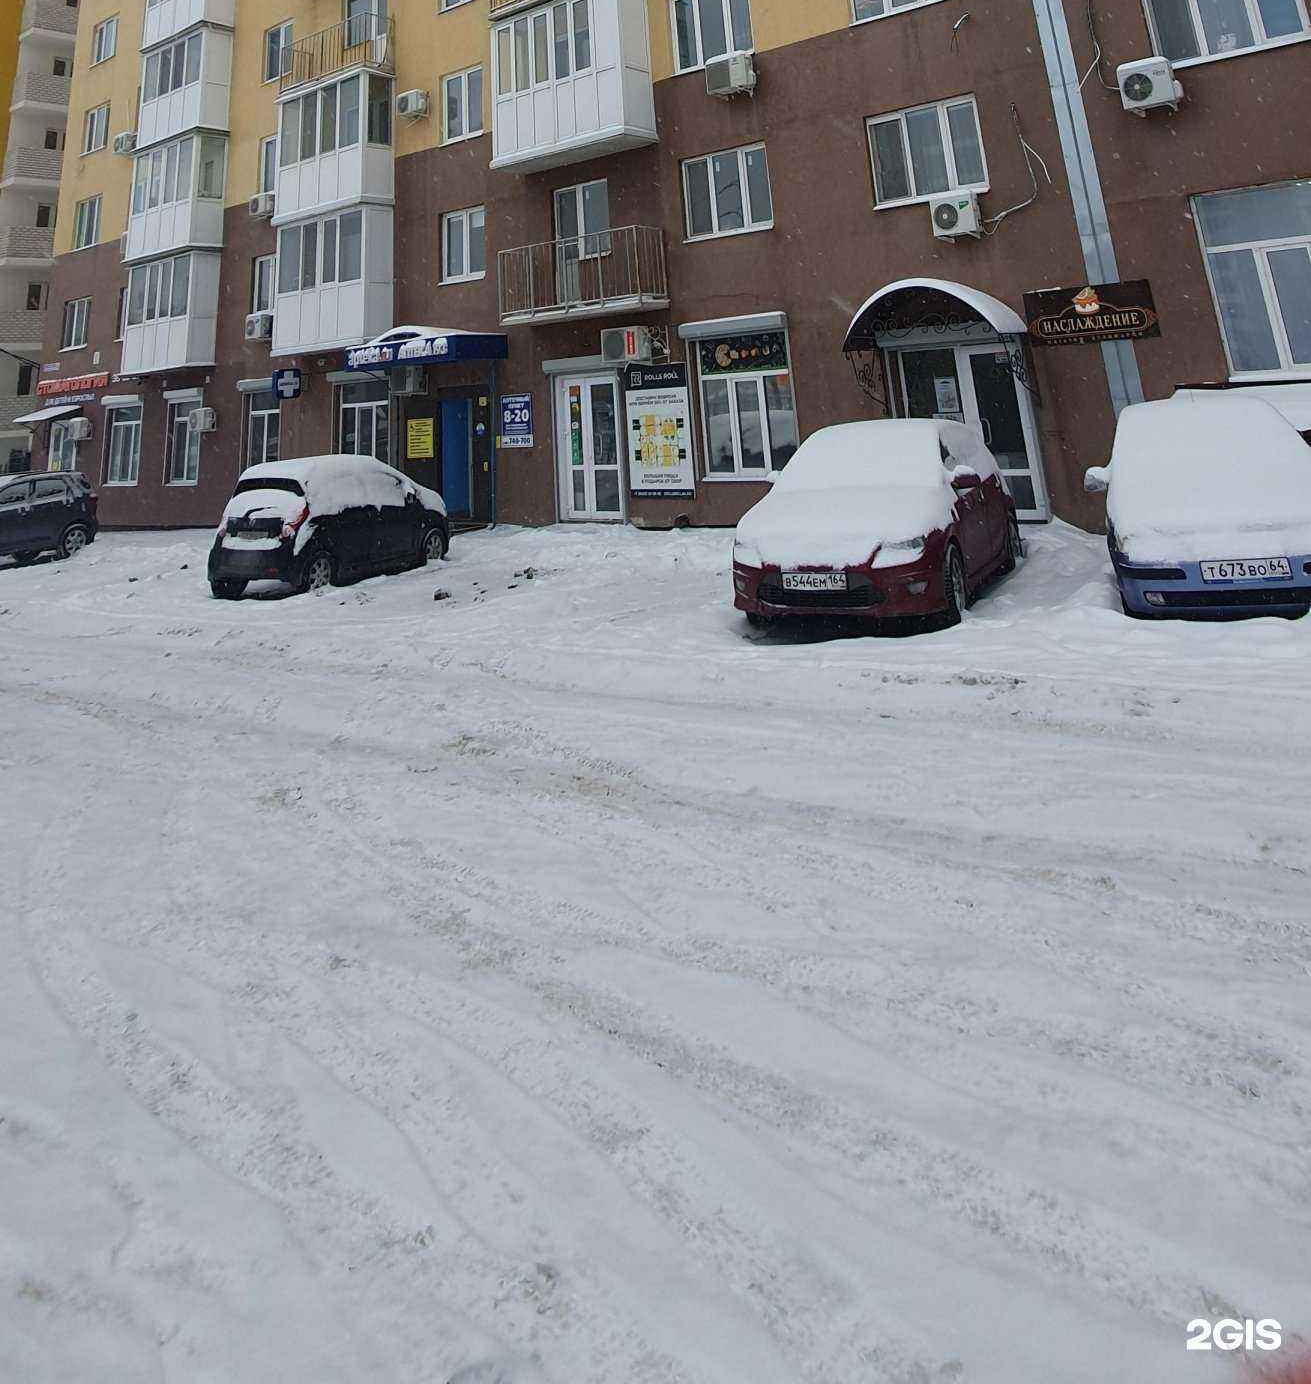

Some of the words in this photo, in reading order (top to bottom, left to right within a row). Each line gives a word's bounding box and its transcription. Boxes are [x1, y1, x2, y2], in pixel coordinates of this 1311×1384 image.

[1043, 312, 1140, 333] НАСЛАЖДЕНИЕ
[503, 409, 530, 423] 8-20
[1207, 562, 1267, 578] Т673ВО
[1269, 560, 1285, 571] 64
[785, 575, 827, 588] В544ЕМ
[828, 574, 846, 585] 164
